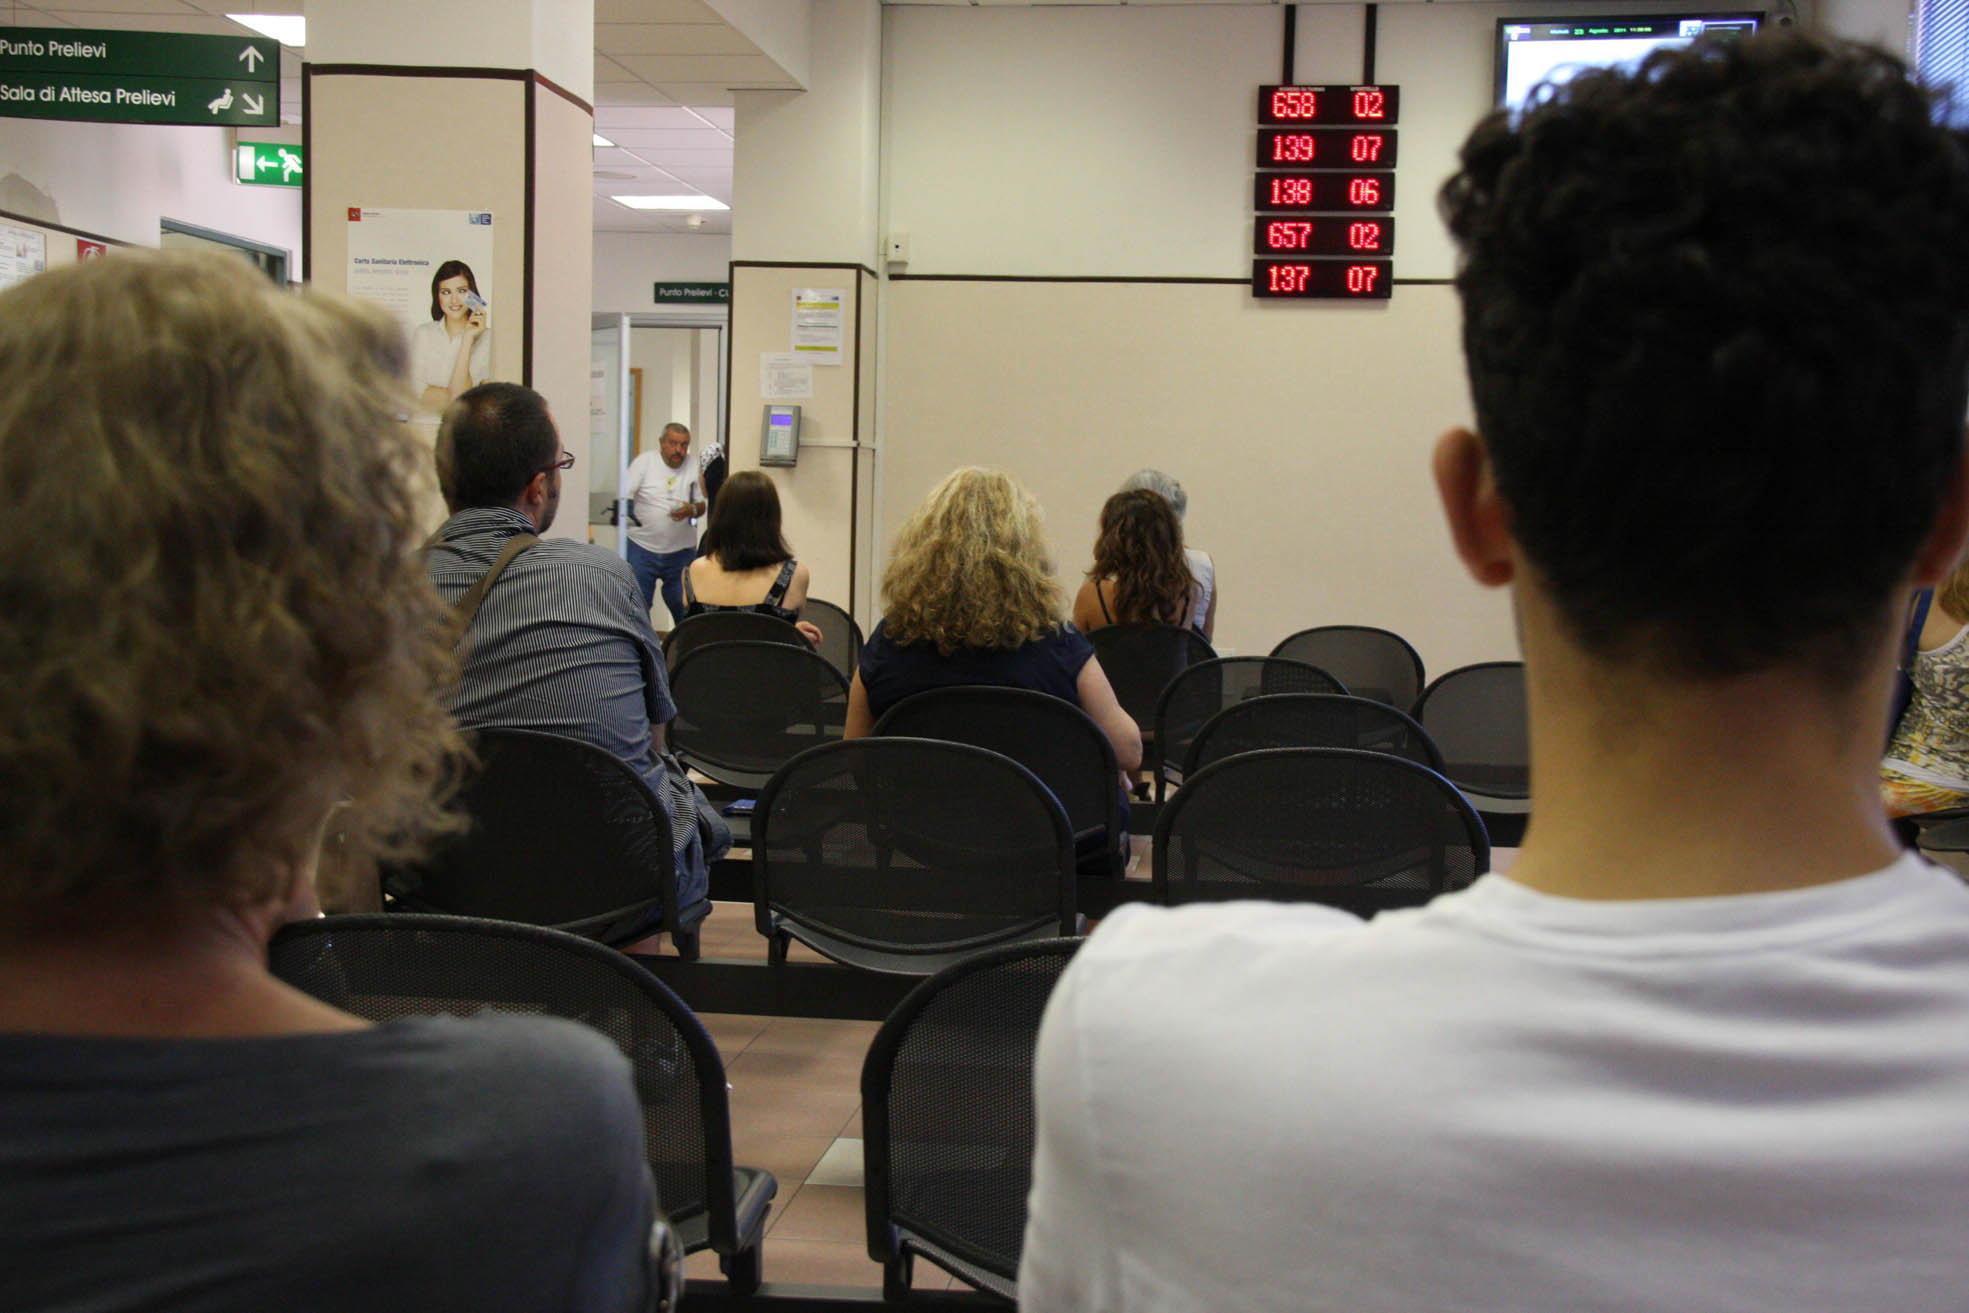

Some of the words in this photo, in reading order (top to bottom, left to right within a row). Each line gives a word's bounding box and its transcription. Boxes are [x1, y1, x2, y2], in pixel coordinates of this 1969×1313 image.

[0, 40, 44, 56] Punto
[49, 41, 107, 59] Prelievi
[0, 85, 35, 101] Sala
[40, 86, 55, 102] di
[59, 86, 111, 104] Attesa
[116, 88, 176, 107] Prelievi
[1272, 92, 1315, 117] 658
[1354, 92, 1383, 117] 02
[1273, 135, 1313, 160] 139
[1352, 136, 1381, 161] 07
[1270, 179, 1312, 204] 138
[1350, 179, 1379, 204] 06
[1269, 222, 1312, 248] 657
[1350, 223, 1380, 248] 02
[1269, 266, 1309, 291] 137
[1348, 267, 1377, 292] 07
[659, 288, 682, 297] Punto
[683, 288, 713, 297] Prelievi
